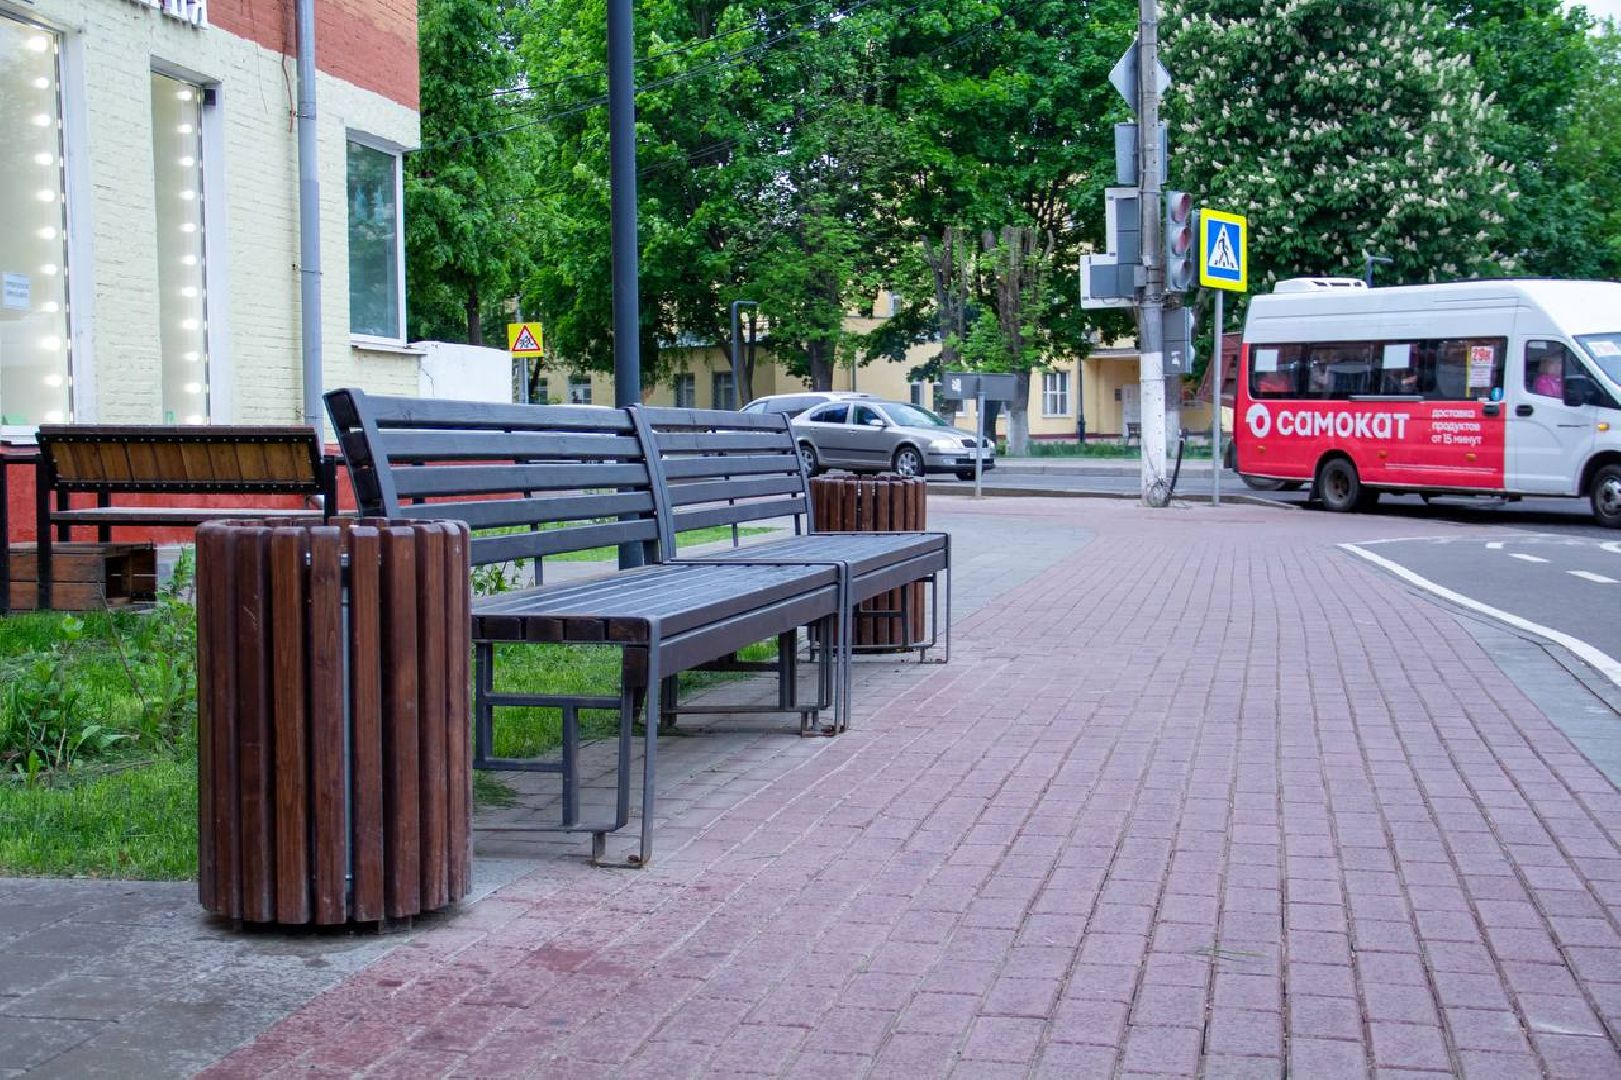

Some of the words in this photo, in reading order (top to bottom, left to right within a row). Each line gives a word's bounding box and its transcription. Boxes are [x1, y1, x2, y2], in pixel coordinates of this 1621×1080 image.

[1276, 410, 1410, 439] самокат
[1431, 434, 1442, 444] от
[1443, 433, 1453, 444] 15
[1453, 435, 1482, 447] минут
